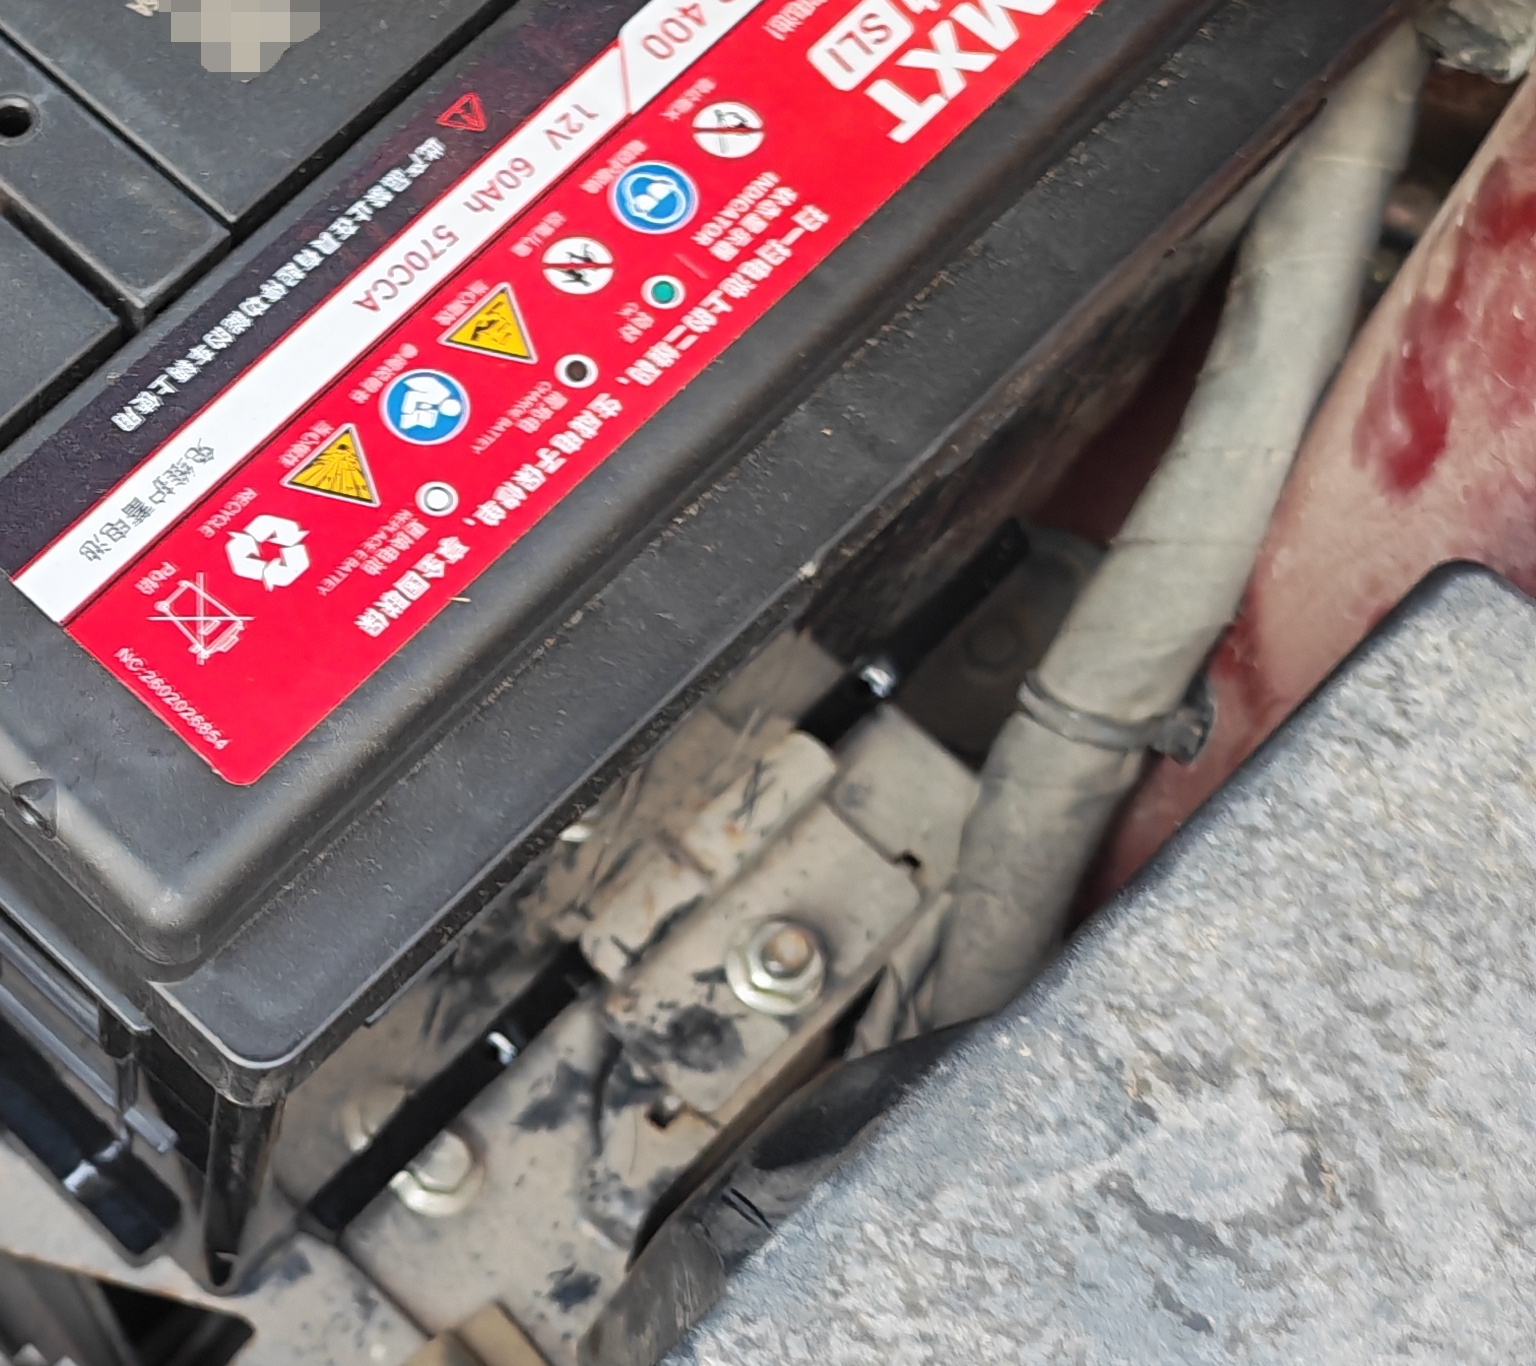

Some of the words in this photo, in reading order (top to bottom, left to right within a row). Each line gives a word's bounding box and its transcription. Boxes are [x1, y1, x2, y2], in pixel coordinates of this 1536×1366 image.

[640, 1, 707, 61] 400
[825, 10, 893, 74] SLI
[542, 102, 600, 152] 12V
[461, 155, 536, 214] 60Ah
[691, 170, 780, 247] INDICATOR
[350, 222, 460, 313] 570CCA
[77, 437, 215, 562] 免维护蓄电池
[197, 485, 259, 539] RECYCLE
